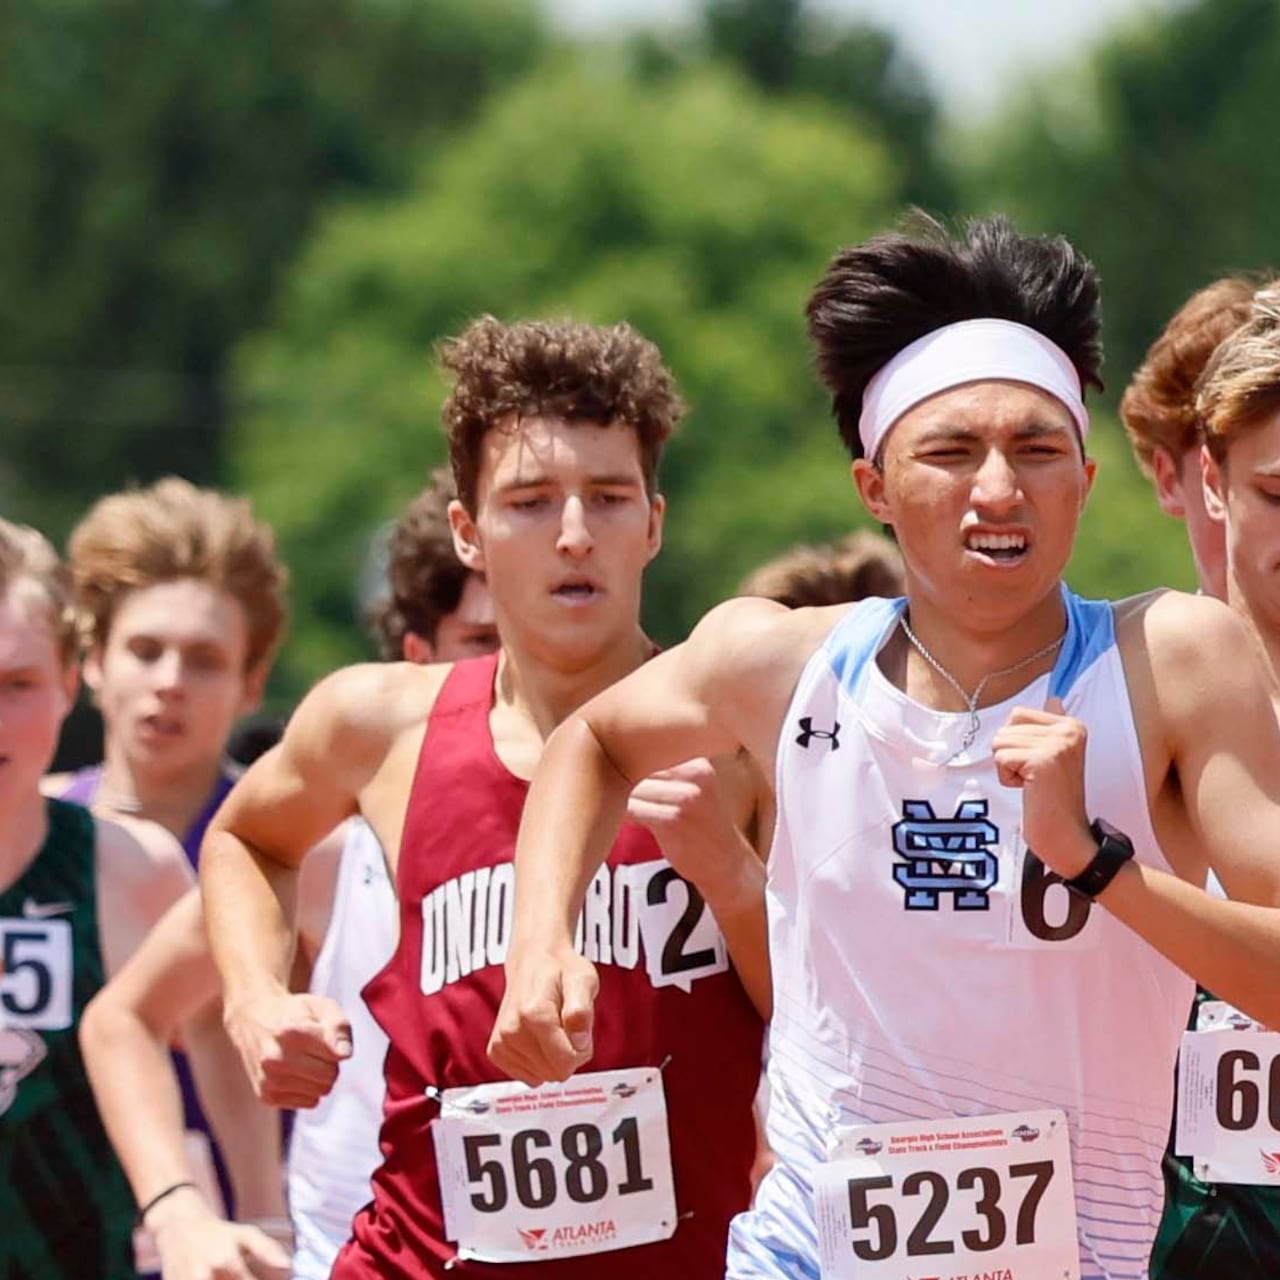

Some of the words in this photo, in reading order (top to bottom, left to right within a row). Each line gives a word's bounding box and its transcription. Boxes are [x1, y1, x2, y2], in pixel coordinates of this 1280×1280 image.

[420, 862, 516, 996] UNIO
[647, 867, 717, 975] 2
[1021, 848, 1091, 942] 6
[0, 932, 52, 1016] 5
[463, 1117, 653, 1213] 5681
[847, 1160, 1055, 1261] 5237
[552, 1219, 615, 1241] ATLANTA
